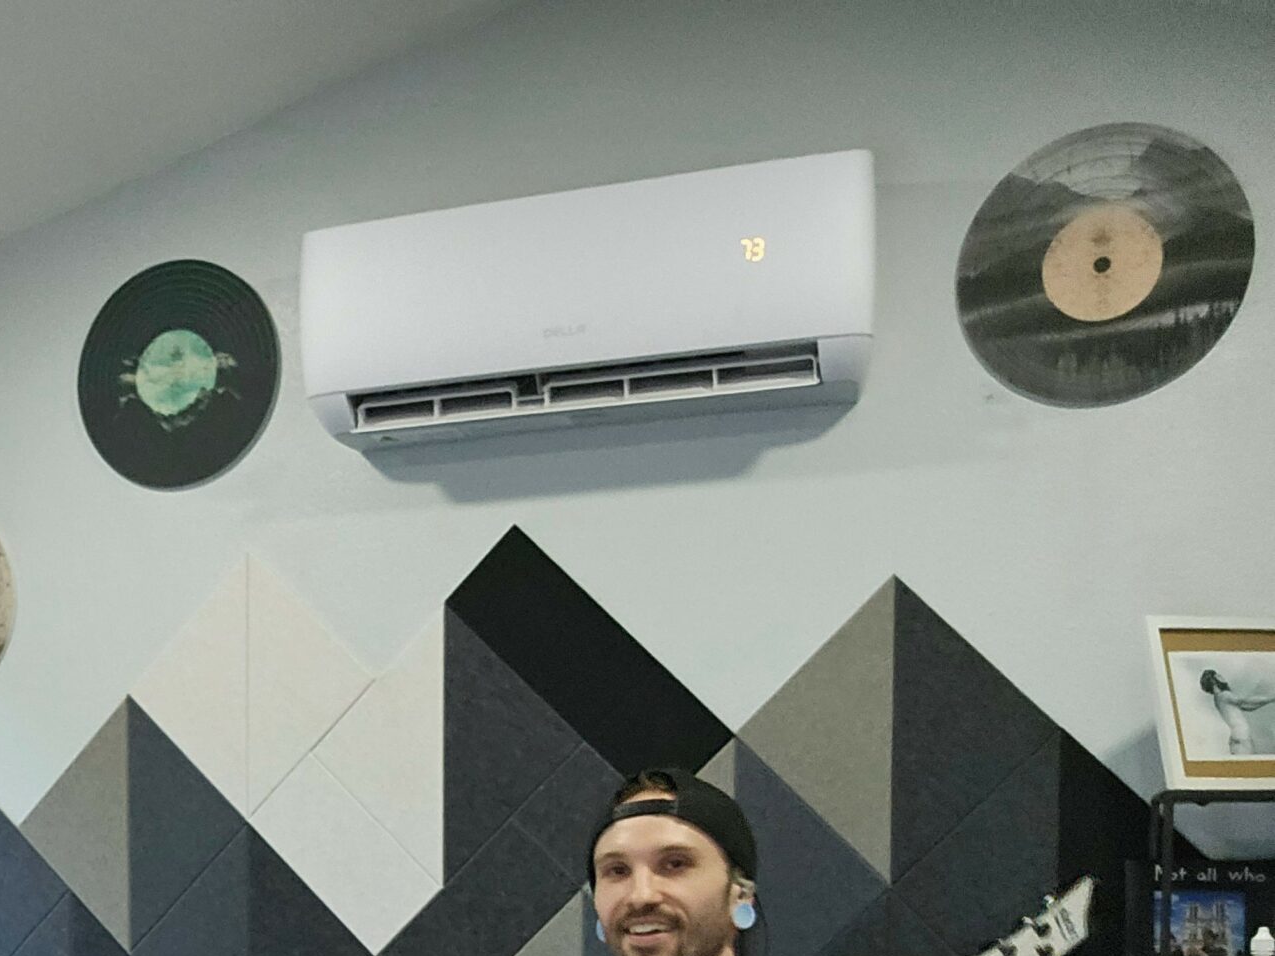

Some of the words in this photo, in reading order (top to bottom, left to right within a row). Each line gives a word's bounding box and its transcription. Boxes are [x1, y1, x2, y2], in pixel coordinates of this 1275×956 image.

[740, 236, 766, 262] 73
[1196, 867, 1217, 882] all
[1228, 866, 1266, 882] who
